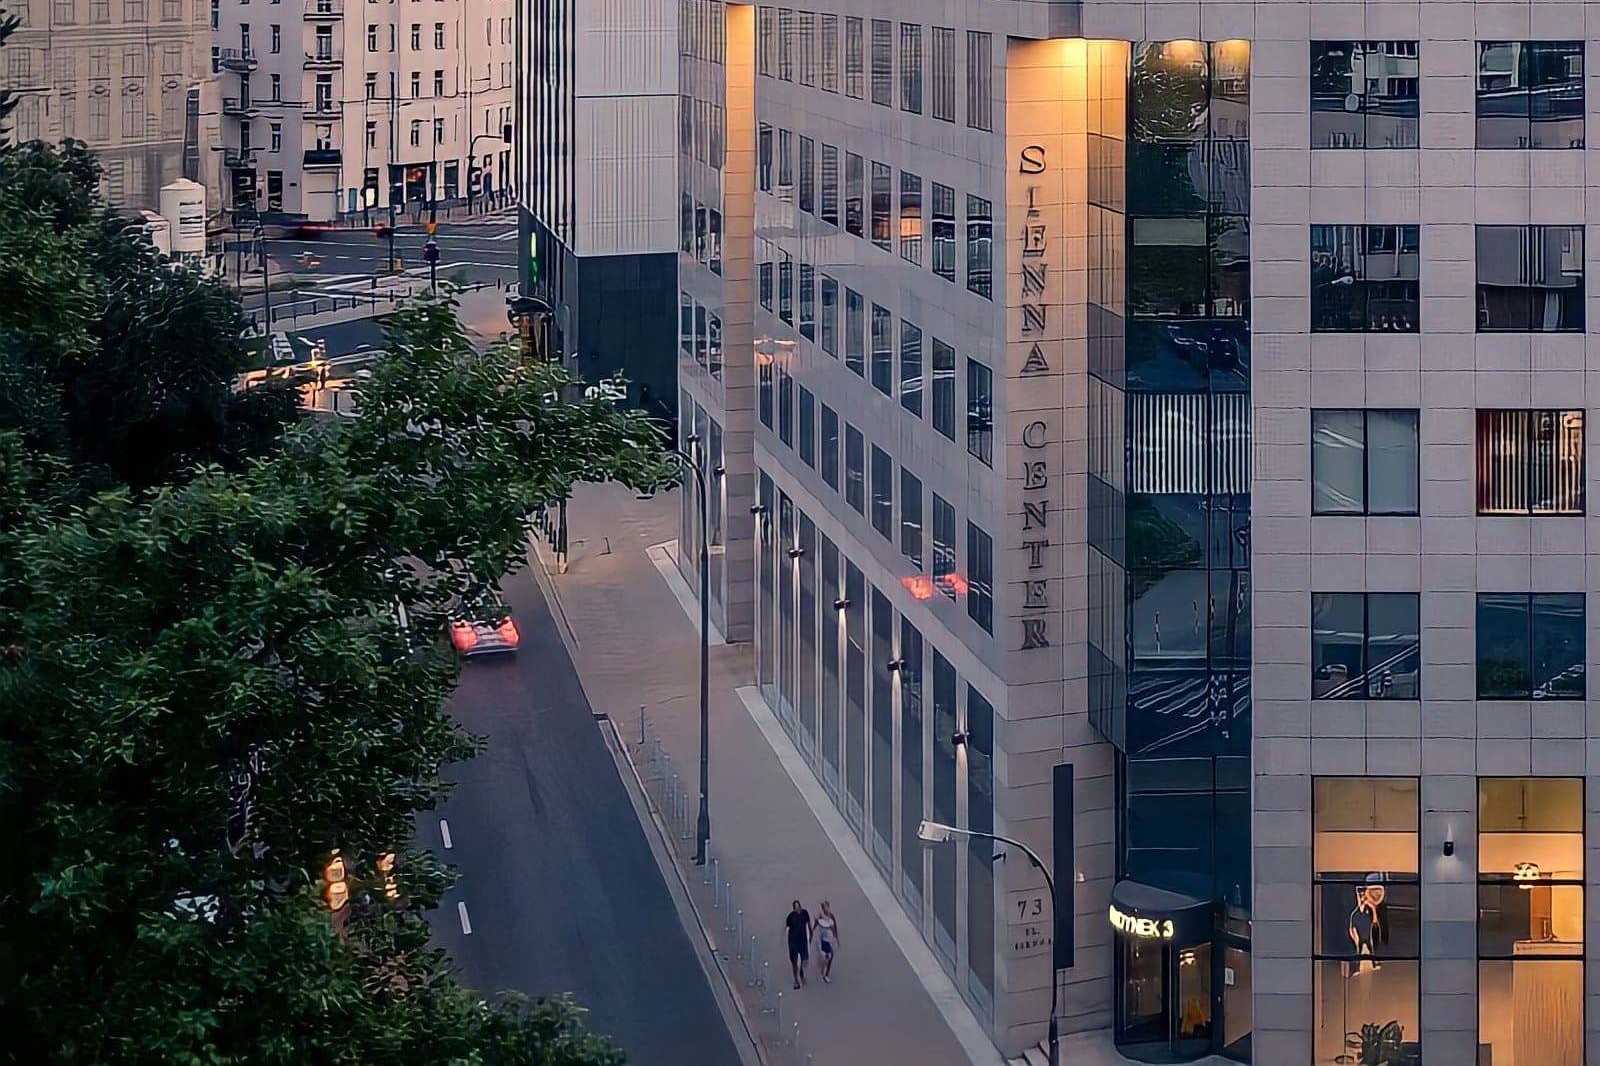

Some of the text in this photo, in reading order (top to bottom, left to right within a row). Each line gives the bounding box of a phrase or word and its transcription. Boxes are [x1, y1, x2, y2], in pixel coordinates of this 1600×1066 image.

[1019, 145, 1049, 374] SIENNA
[1022, 420, 1050, 651] CENTER
[1017, 898, 1042, 920] 73
